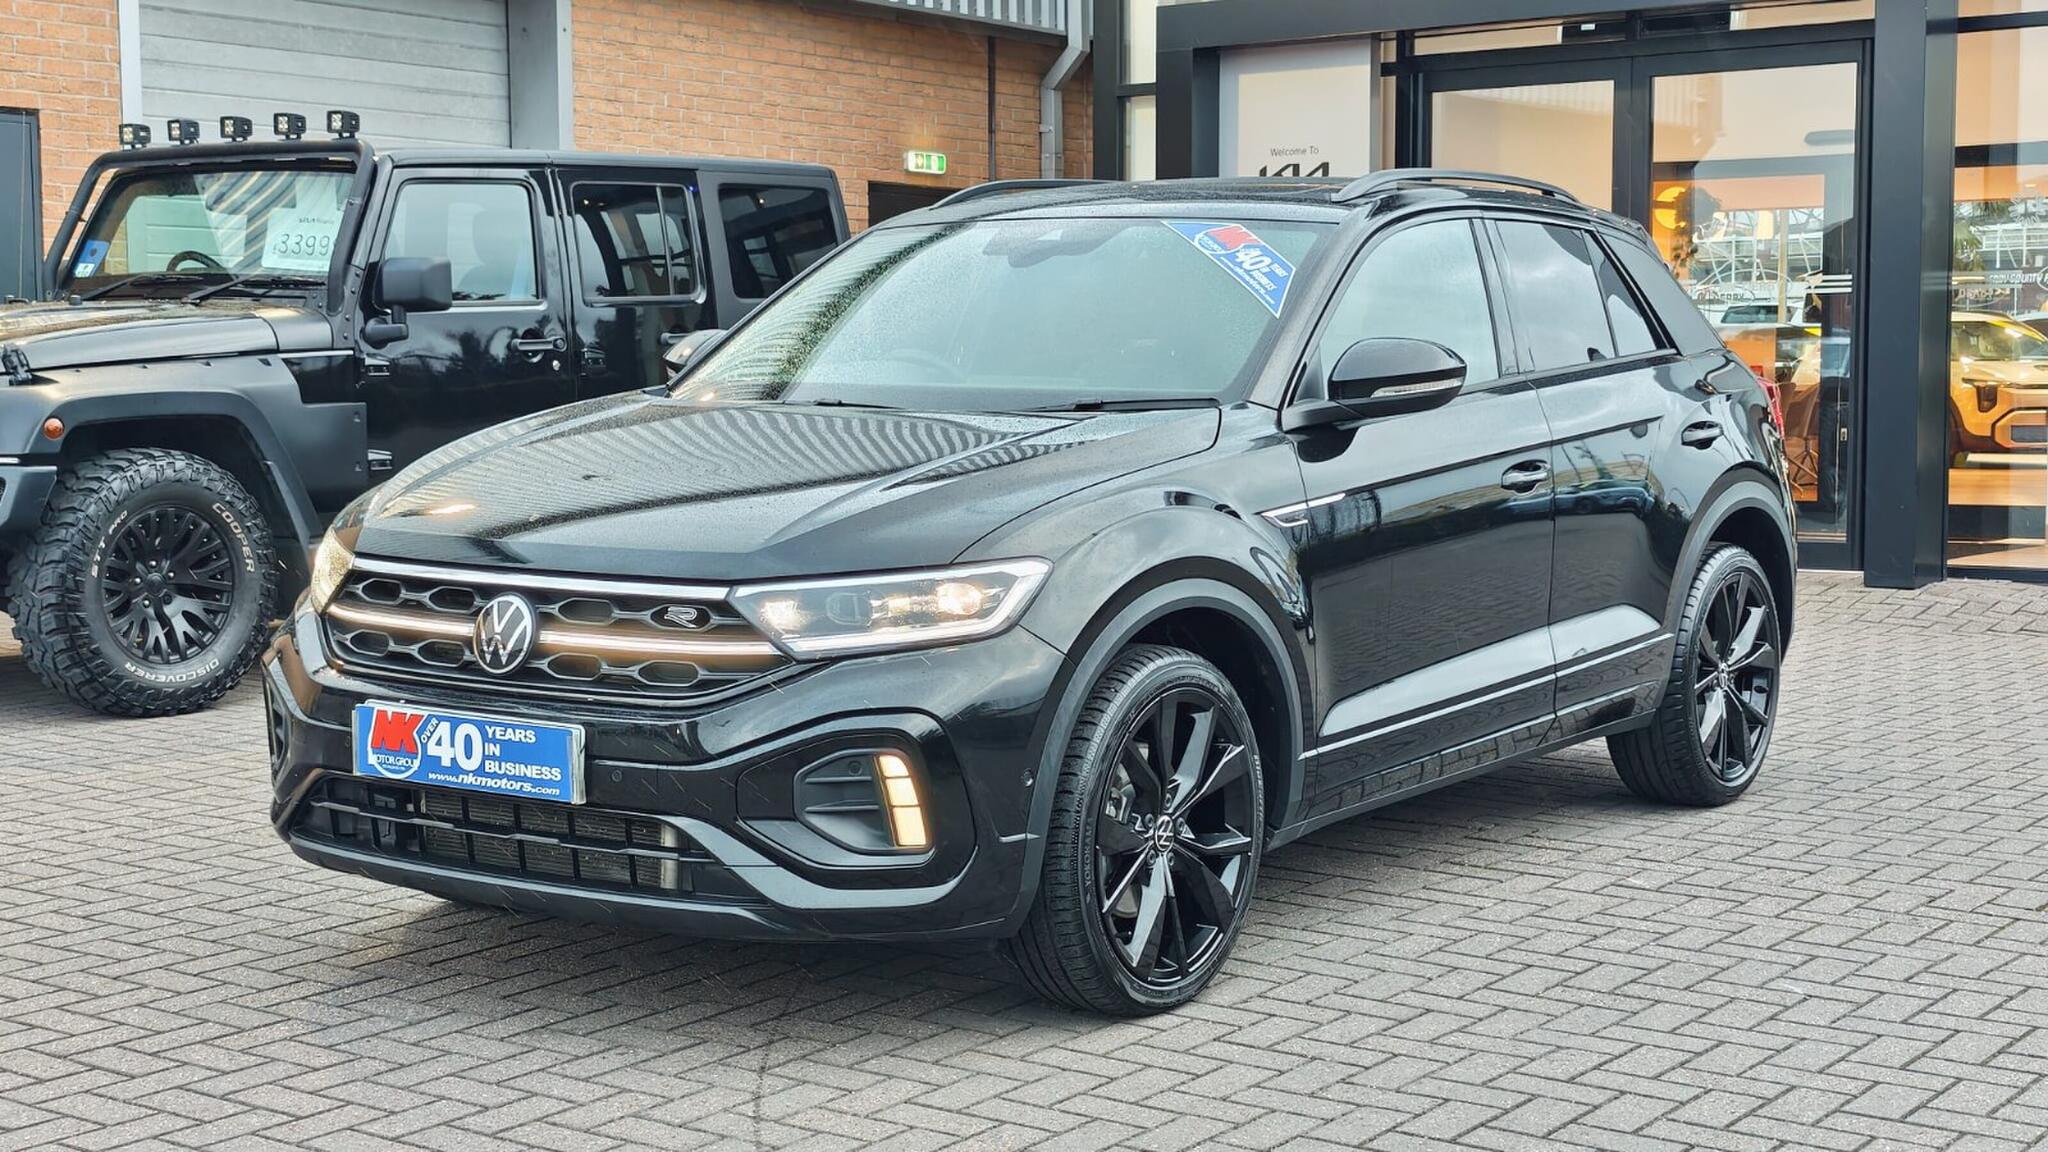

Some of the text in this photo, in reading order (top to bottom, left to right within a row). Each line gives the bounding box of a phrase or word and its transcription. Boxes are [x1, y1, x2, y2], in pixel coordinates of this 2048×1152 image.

[1270, 145, 1320, 157] Welcome To
[1235, 248, 1273, 271] 40
[108, 510, 128, 535] PRO
[212, 502, 256, 573] COOPER
[124, 658, 220, 683] DISCOVERER
[370, 709, 425, 754] NK
[421, 718, 440, 744] OVER
[484, 725, 537, 744] YEARS
[427, 720, 483, 771] 40
[484, 743, 500, 757] IN
[484, 759, 562, 782] BUSINESS
[428, 772, 560, 796] www.nkmotors.com
